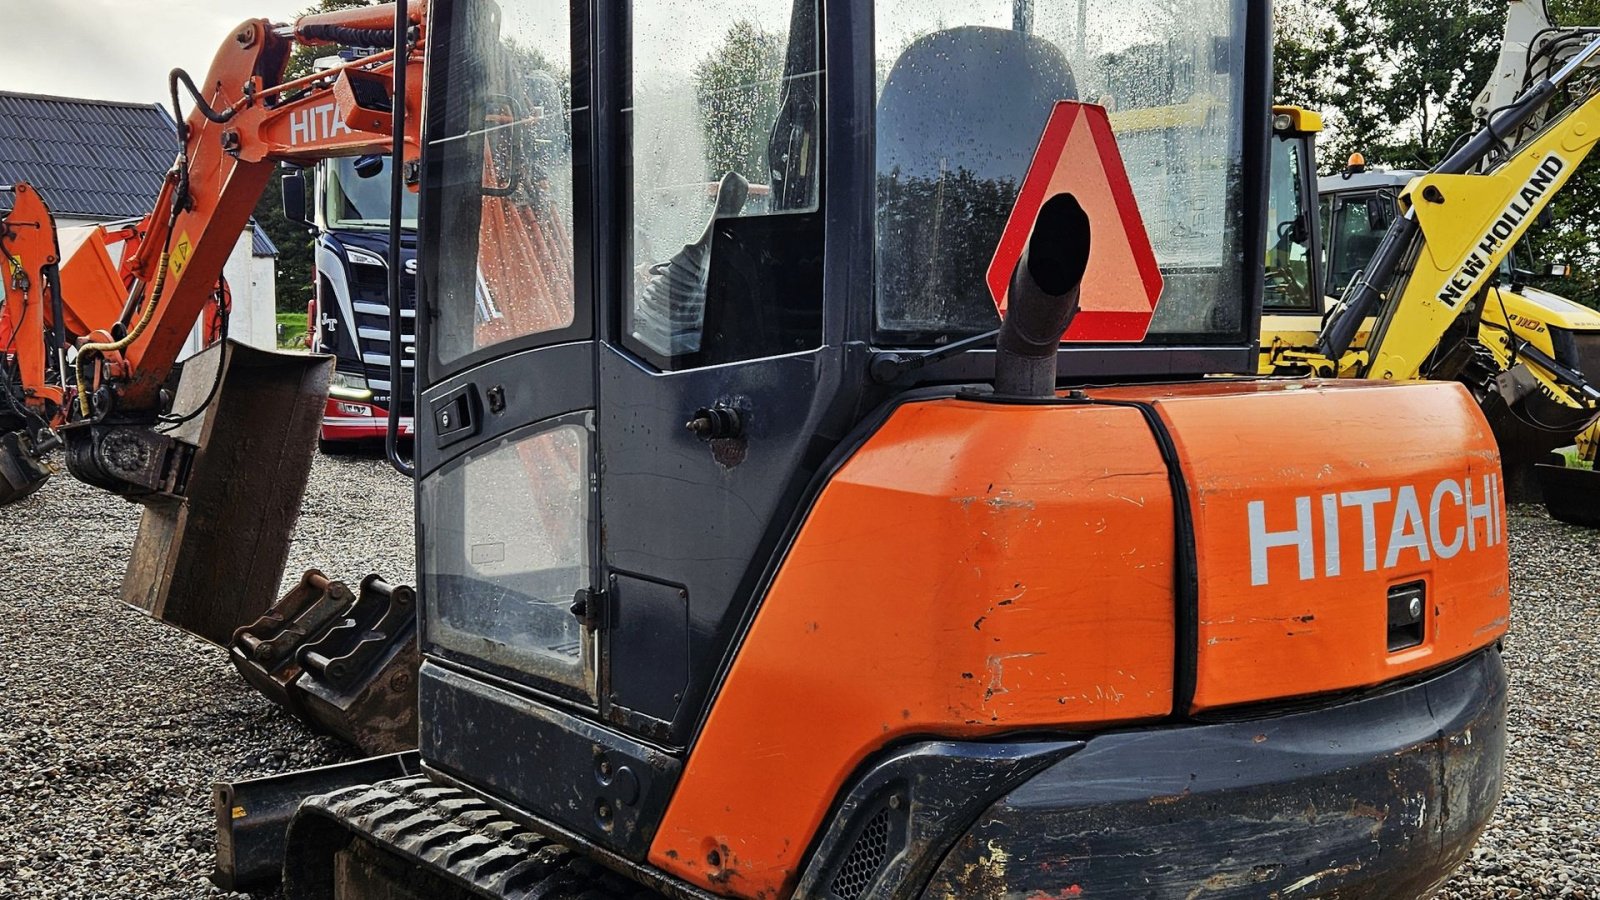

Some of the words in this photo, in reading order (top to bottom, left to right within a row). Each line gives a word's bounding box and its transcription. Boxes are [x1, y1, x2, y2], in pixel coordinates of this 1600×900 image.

[290, 103, 352, 146] HITA
[1438, 252, 1486, 307] NEW
[1478, 155, 1564, 256] HOLLAND
[1247, 472, 1502, 586] HITACHI
